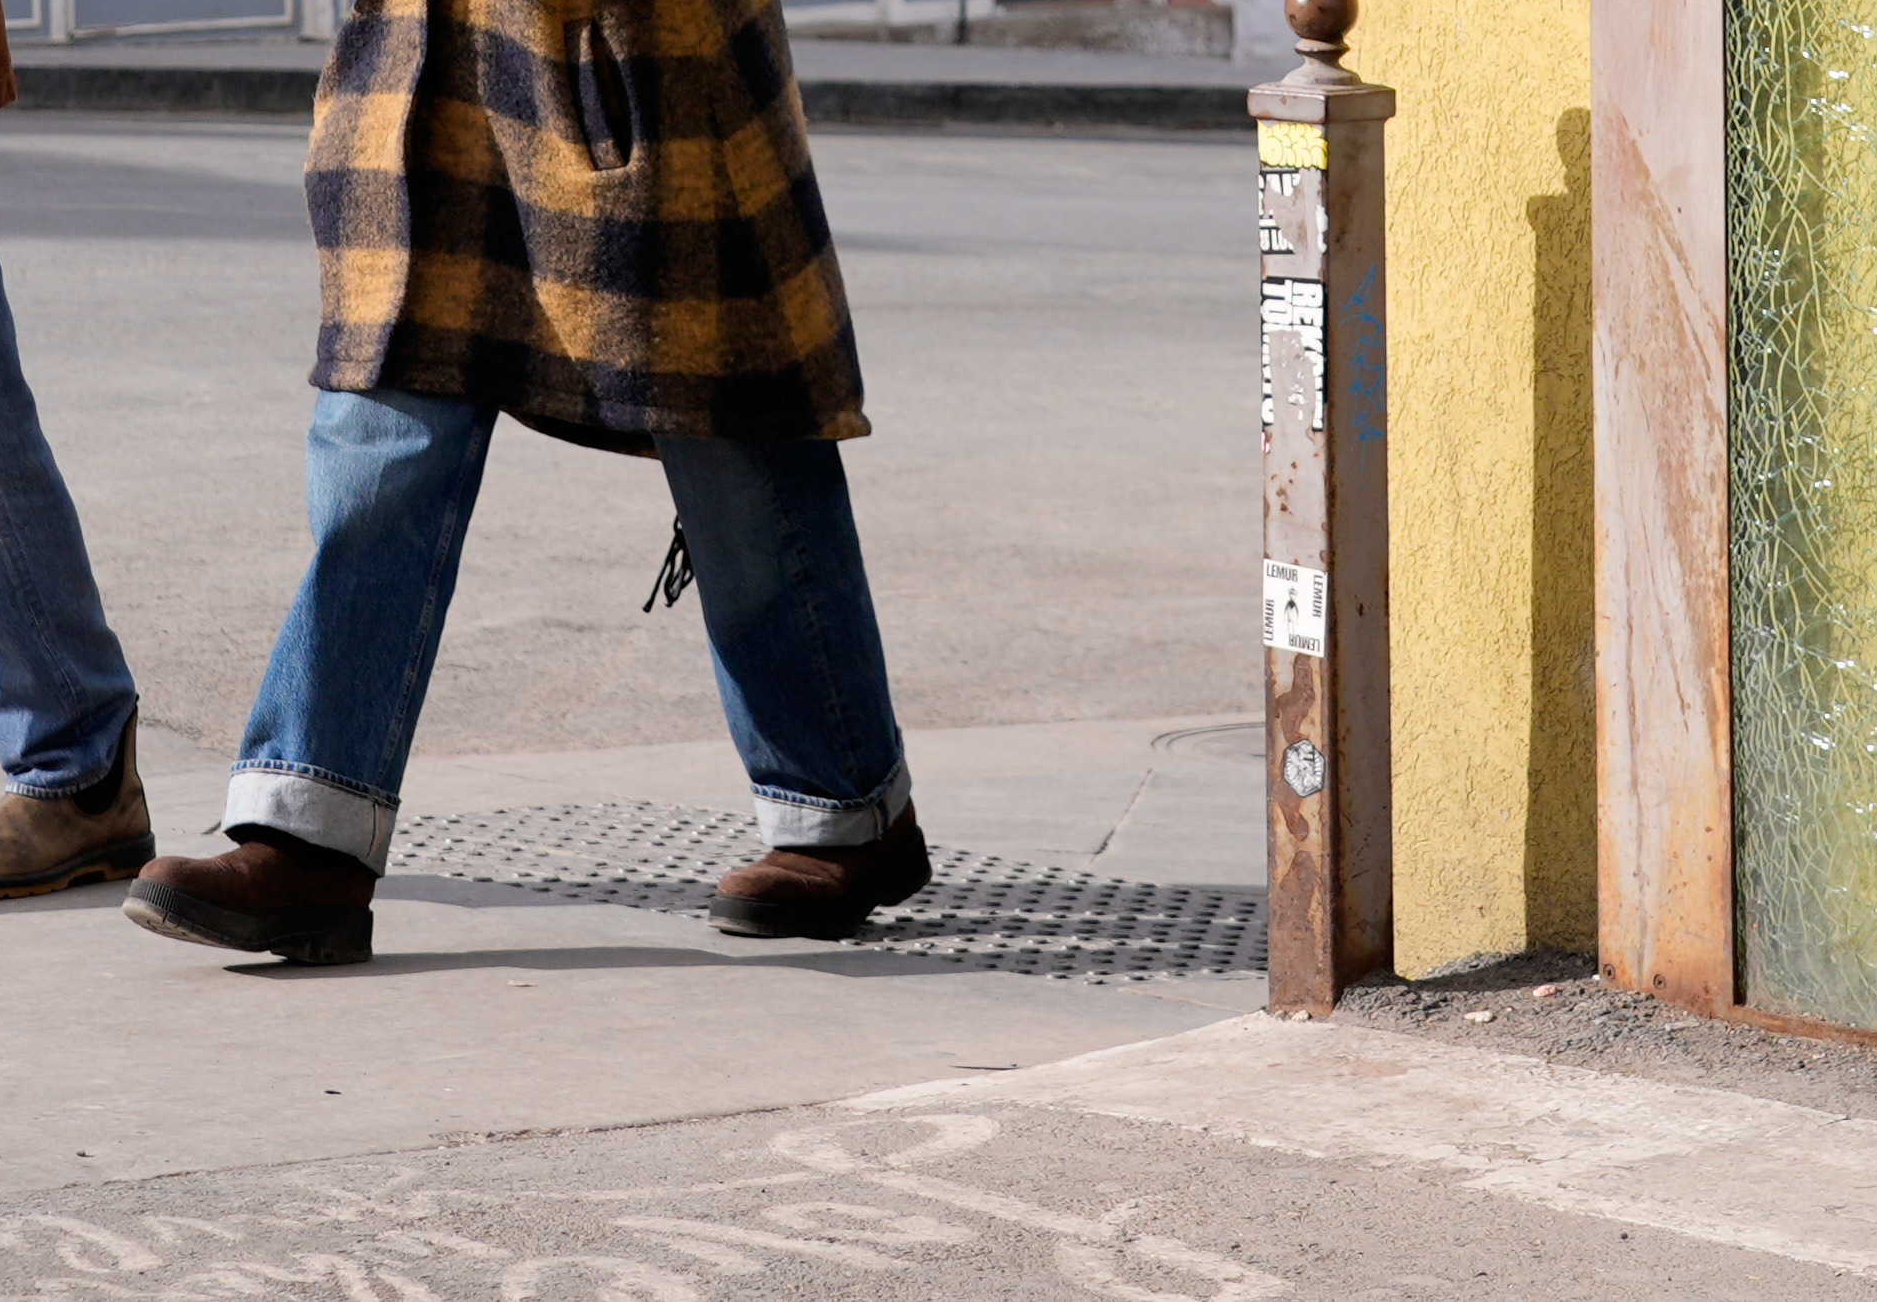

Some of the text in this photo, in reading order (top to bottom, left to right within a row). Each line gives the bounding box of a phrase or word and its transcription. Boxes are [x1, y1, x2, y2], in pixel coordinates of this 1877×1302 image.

[1266, 563, 1298, 582] LEMUR
[1312, 574, 1324, 618] LEMUR
[1263, 598, 1275, 641] LEMUR
[1288, 633, 1320, 652] LEMUR
